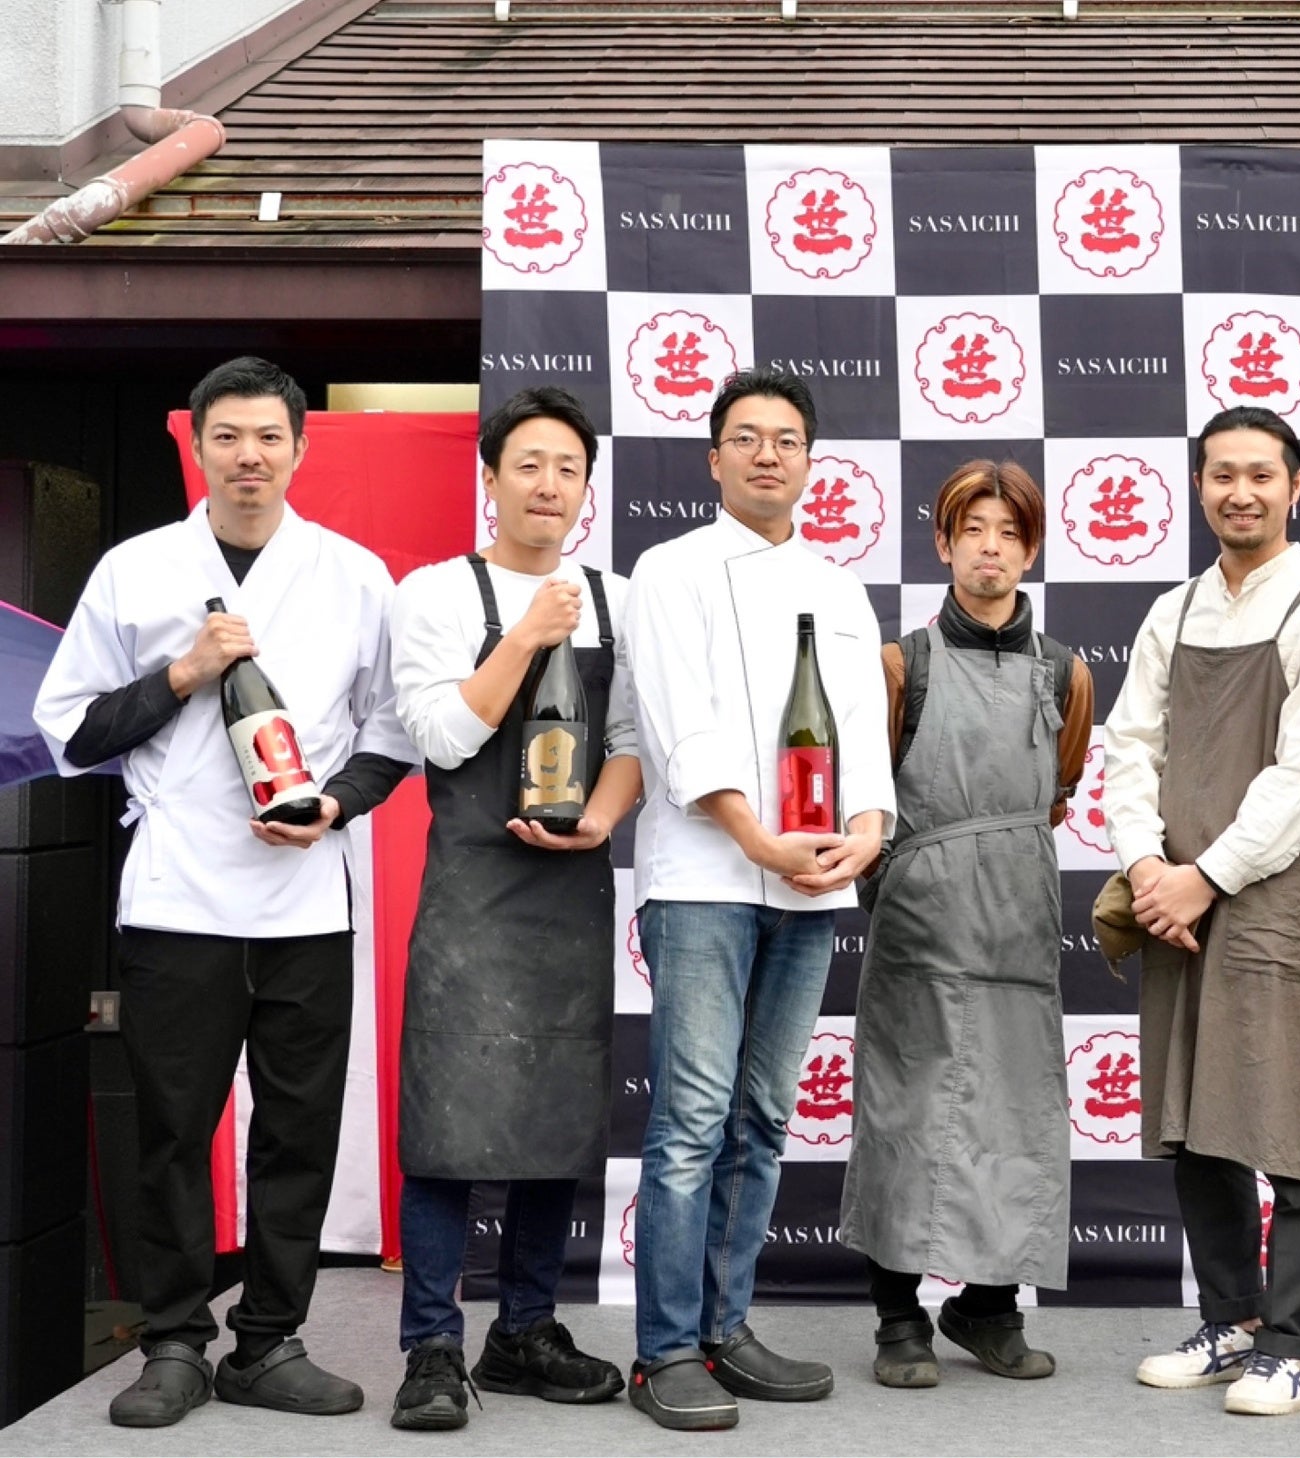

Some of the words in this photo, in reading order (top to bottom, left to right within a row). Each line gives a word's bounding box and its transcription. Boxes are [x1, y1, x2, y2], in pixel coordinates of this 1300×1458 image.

[621, 212, 730, 230] SASAICHI
[910, 215, 1018, 232] SASAICHI
[482, 354, 591, 371] SASAICHI
[771, 360, 879, 376] SASAICHI
[1059, 358, 1166, 374] SASAICHI
